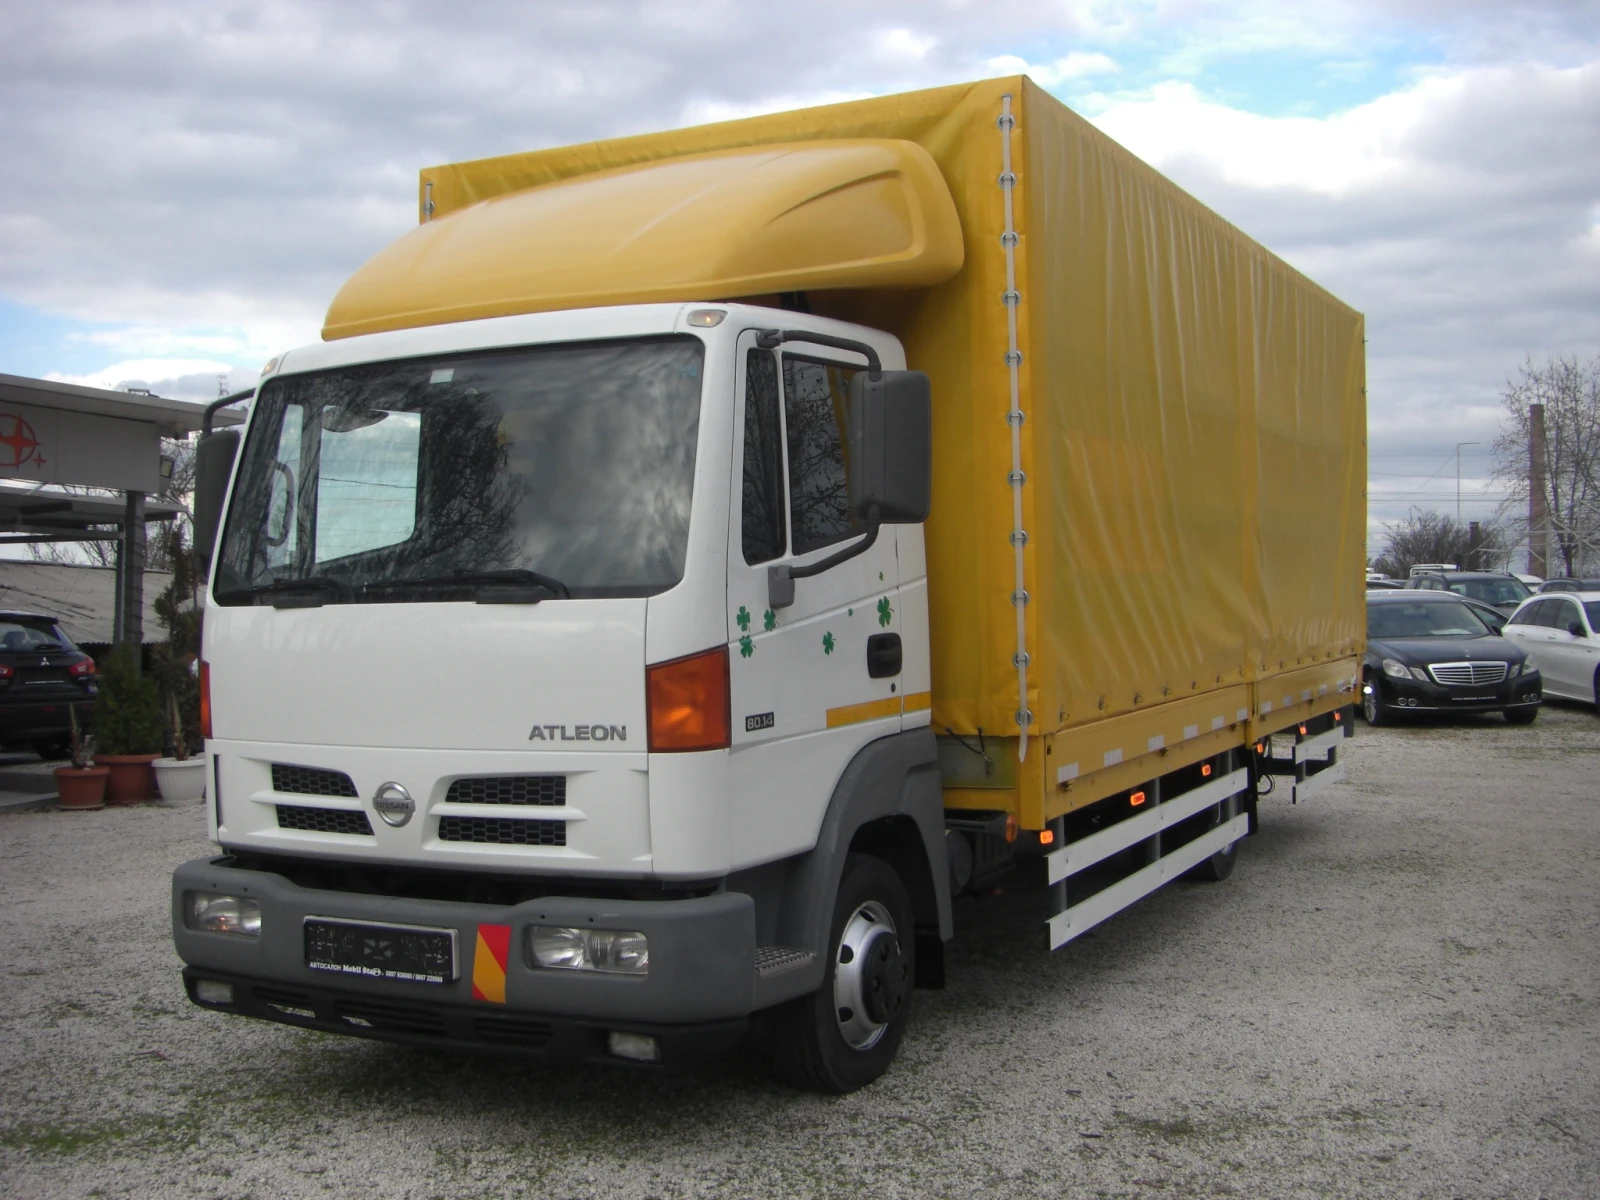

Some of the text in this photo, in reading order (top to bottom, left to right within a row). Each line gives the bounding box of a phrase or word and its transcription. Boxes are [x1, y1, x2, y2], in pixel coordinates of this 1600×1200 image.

[747, 714, 773, 730] 80.14
[528, 724, 627, 741] ATLEON
[376, 801, 409, 810] NISSAN
[309, 961, 342, 972] АВТОСАЛОН
[342, 964, 362, 974] Mobil
